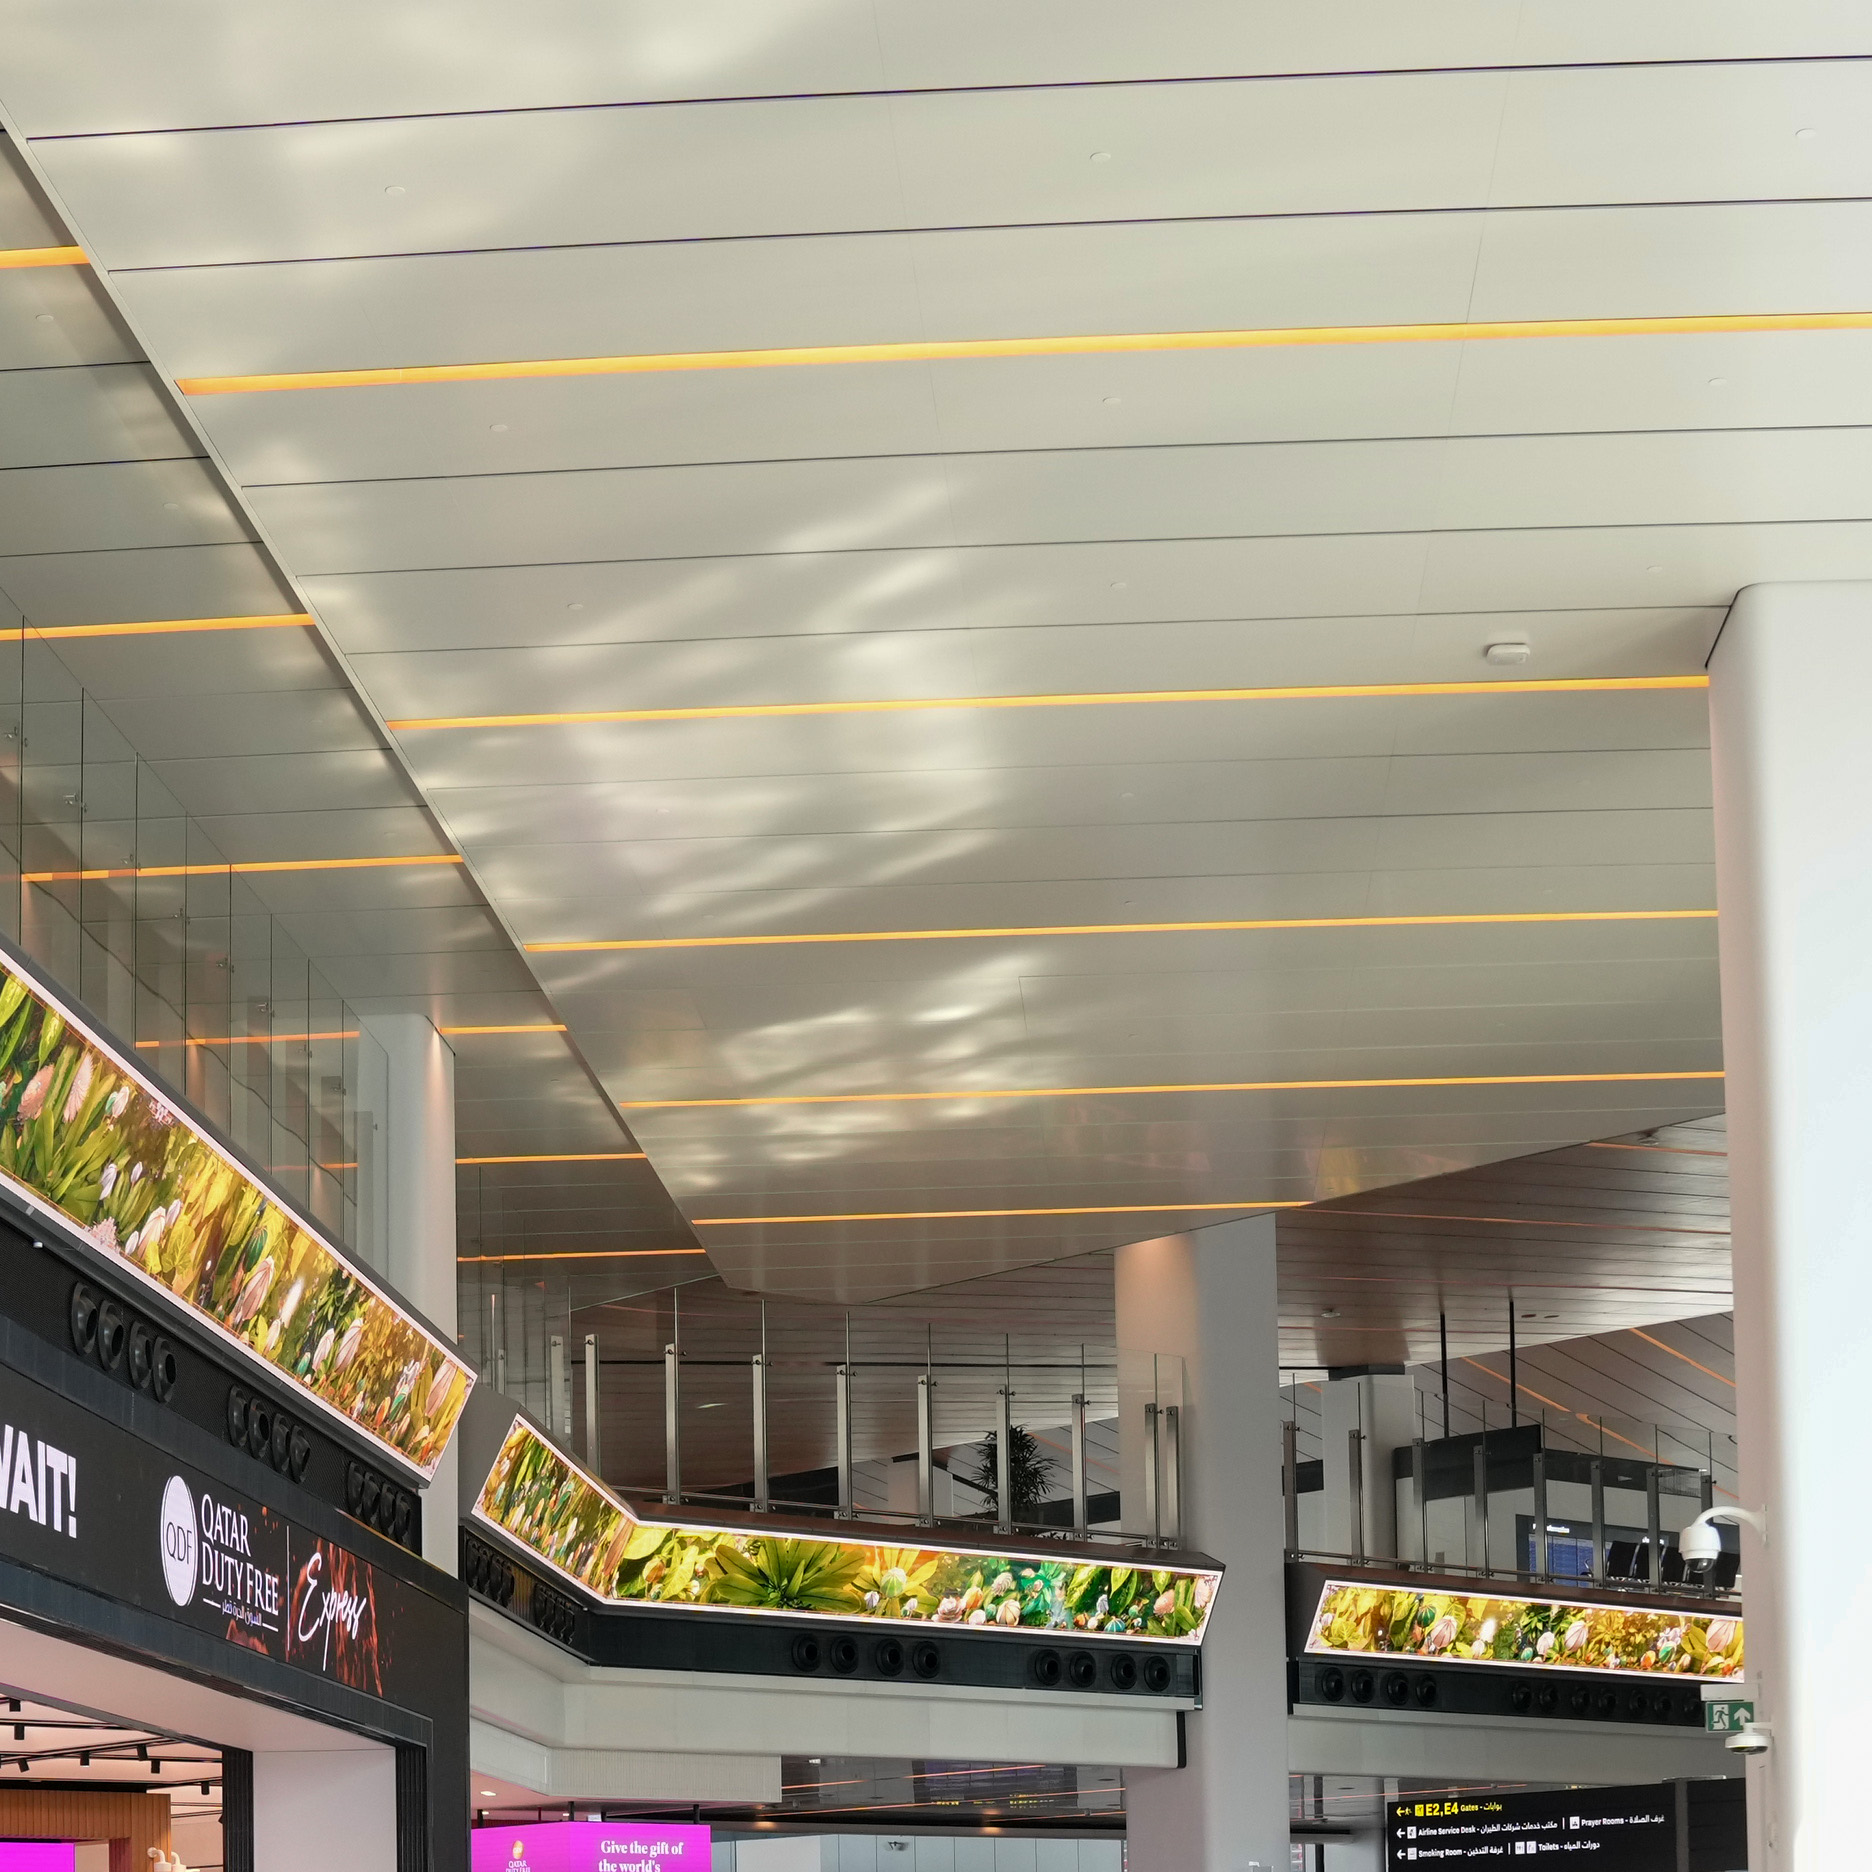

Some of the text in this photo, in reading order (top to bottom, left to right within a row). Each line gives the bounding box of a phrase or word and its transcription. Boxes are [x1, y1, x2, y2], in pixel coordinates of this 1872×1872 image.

[201, 1494, 252, 1557] QATAR
[166, 1521, 193, 1565] QDF
[202, 1541, 279, 1617] DUTY FREE
[298, 1552, 367, 1672] Express
[1425, 1802, 1479, 1818] E2,E4 Gates
[1483, 1803, 1503, 1812] بوابات
[1581, 1817, 1624, 1828] Prayer Rooms
[1418, 1825, 1476, 1837] Airline Service Desk
[600, 1840, 684, 1858] Give the gift of
[1418, 1848, 1463, 1858] Smoking Room
[1538, 1843, 1559, 1851] Toilets
[598, 1859, 661, 1872] the world's
